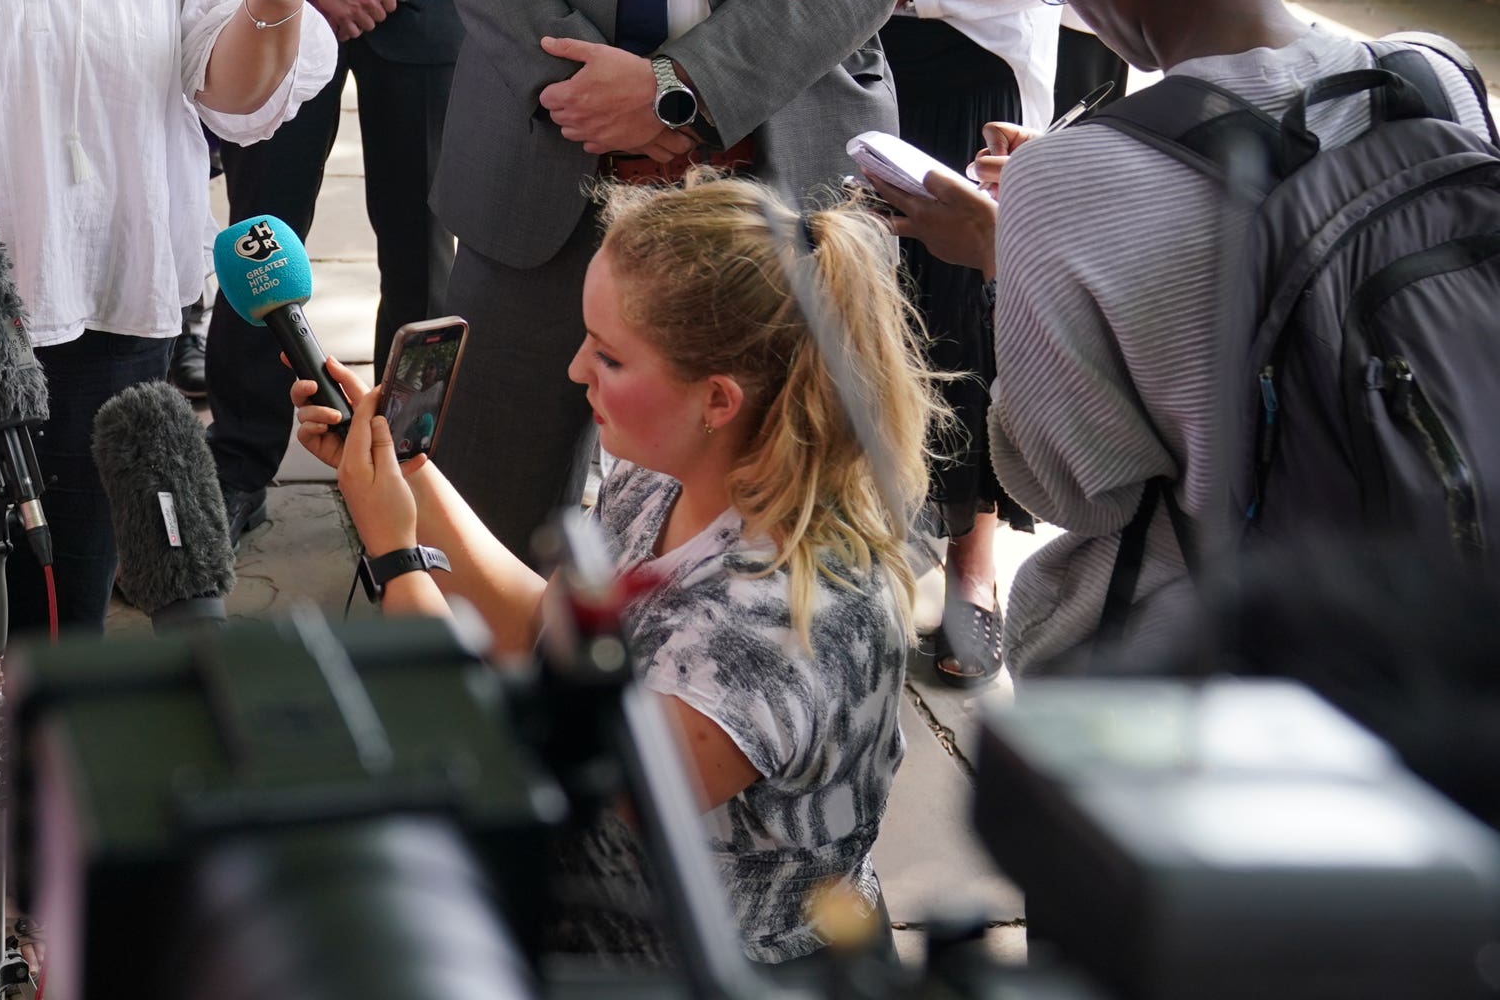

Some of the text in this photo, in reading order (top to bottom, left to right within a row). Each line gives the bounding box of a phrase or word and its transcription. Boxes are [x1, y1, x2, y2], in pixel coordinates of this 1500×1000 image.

[246, 258, 288, 279] GREATEST
[249, 274, 270, 288] HITS
[252, 278, 280, 296] RADIO
